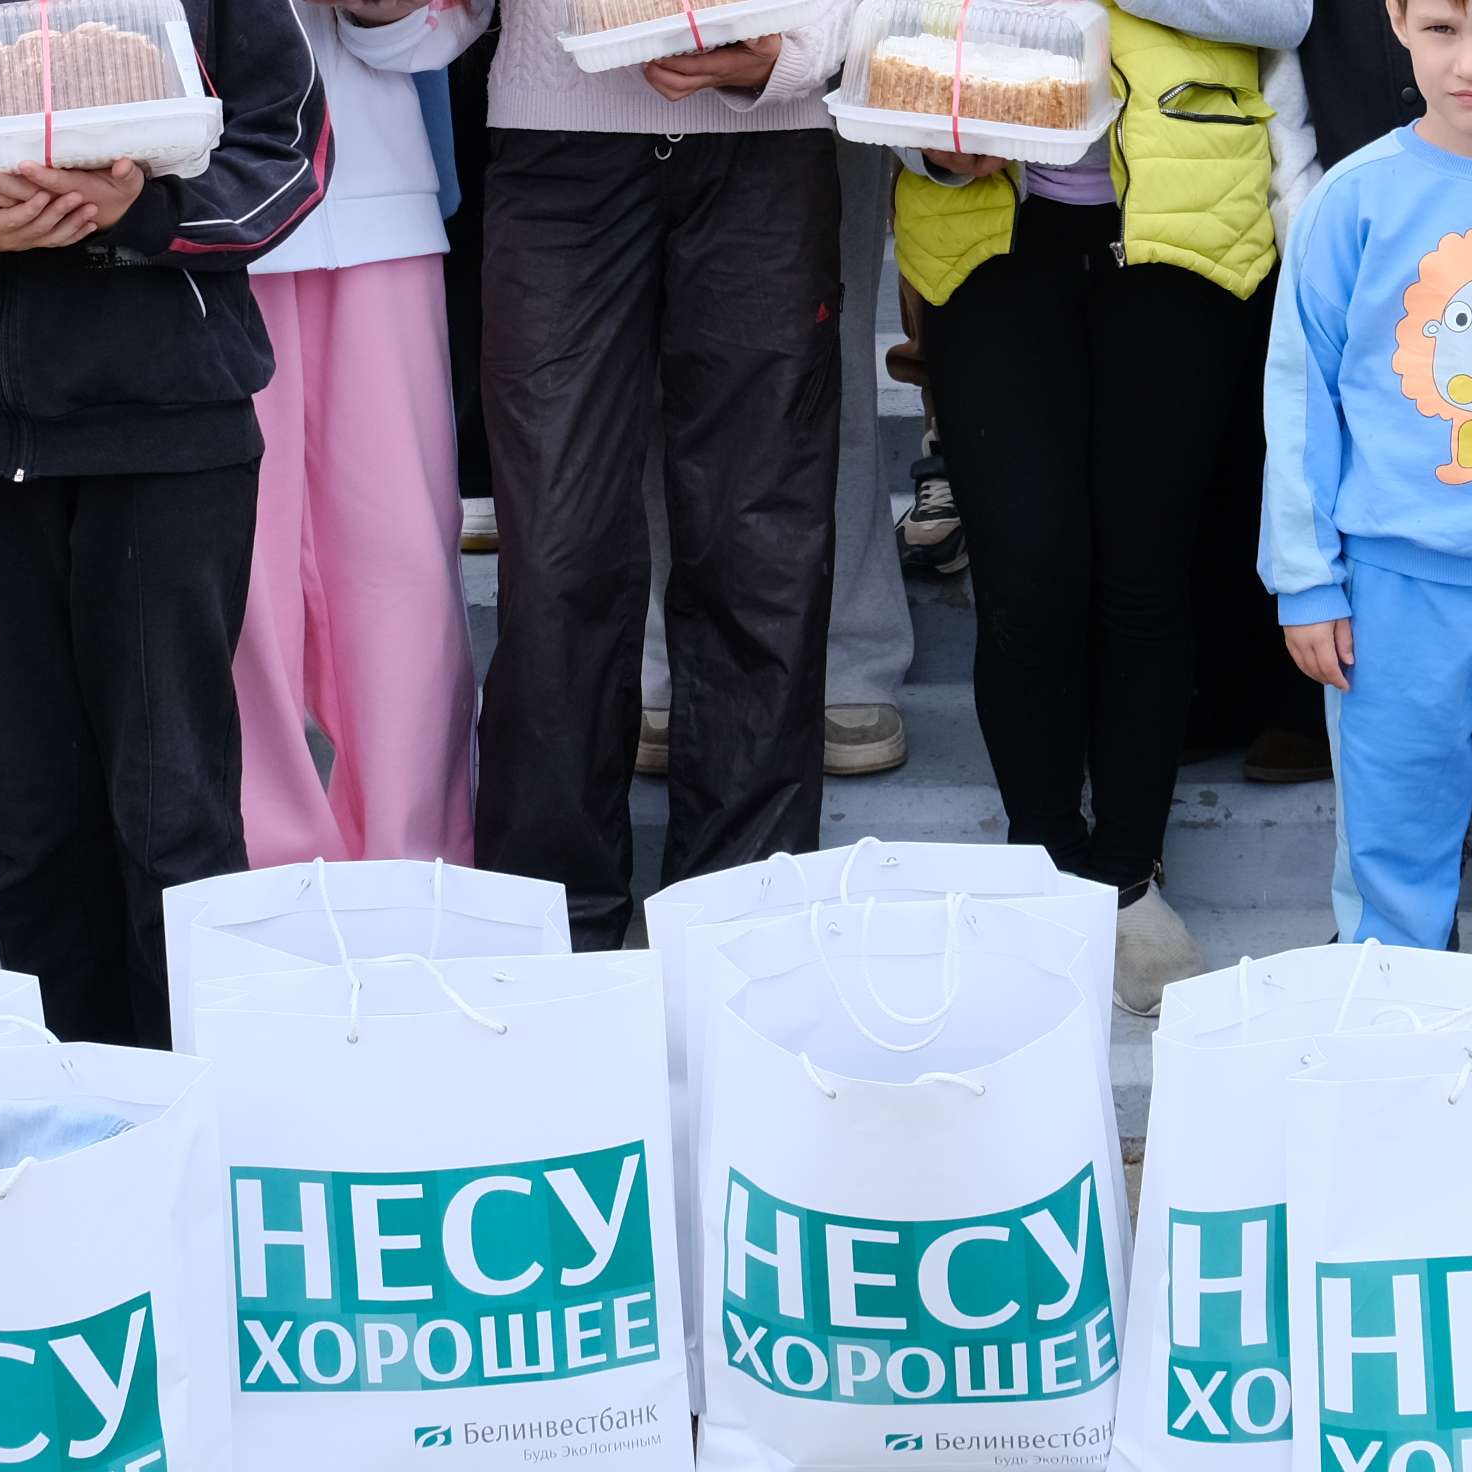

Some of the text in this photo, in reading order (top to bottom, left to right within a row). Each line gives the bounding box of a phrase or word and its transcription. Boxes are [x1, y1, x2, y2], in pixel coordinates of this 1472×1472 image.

[235, 1153, 641, 1301] НЕСУ
[727, 1175, 1092, 1330] НЕСУ
[244, 1292, 656, 1385] ХОРОШЕЕ
[727, 1306, 1118, 1399] ХОРОШЕЕ
[523, 1447, 558, 1464] Будь
[935, 1416, 1116, 1451] Белинвестбан
[994, 1455, 1027, 1466] Будь
